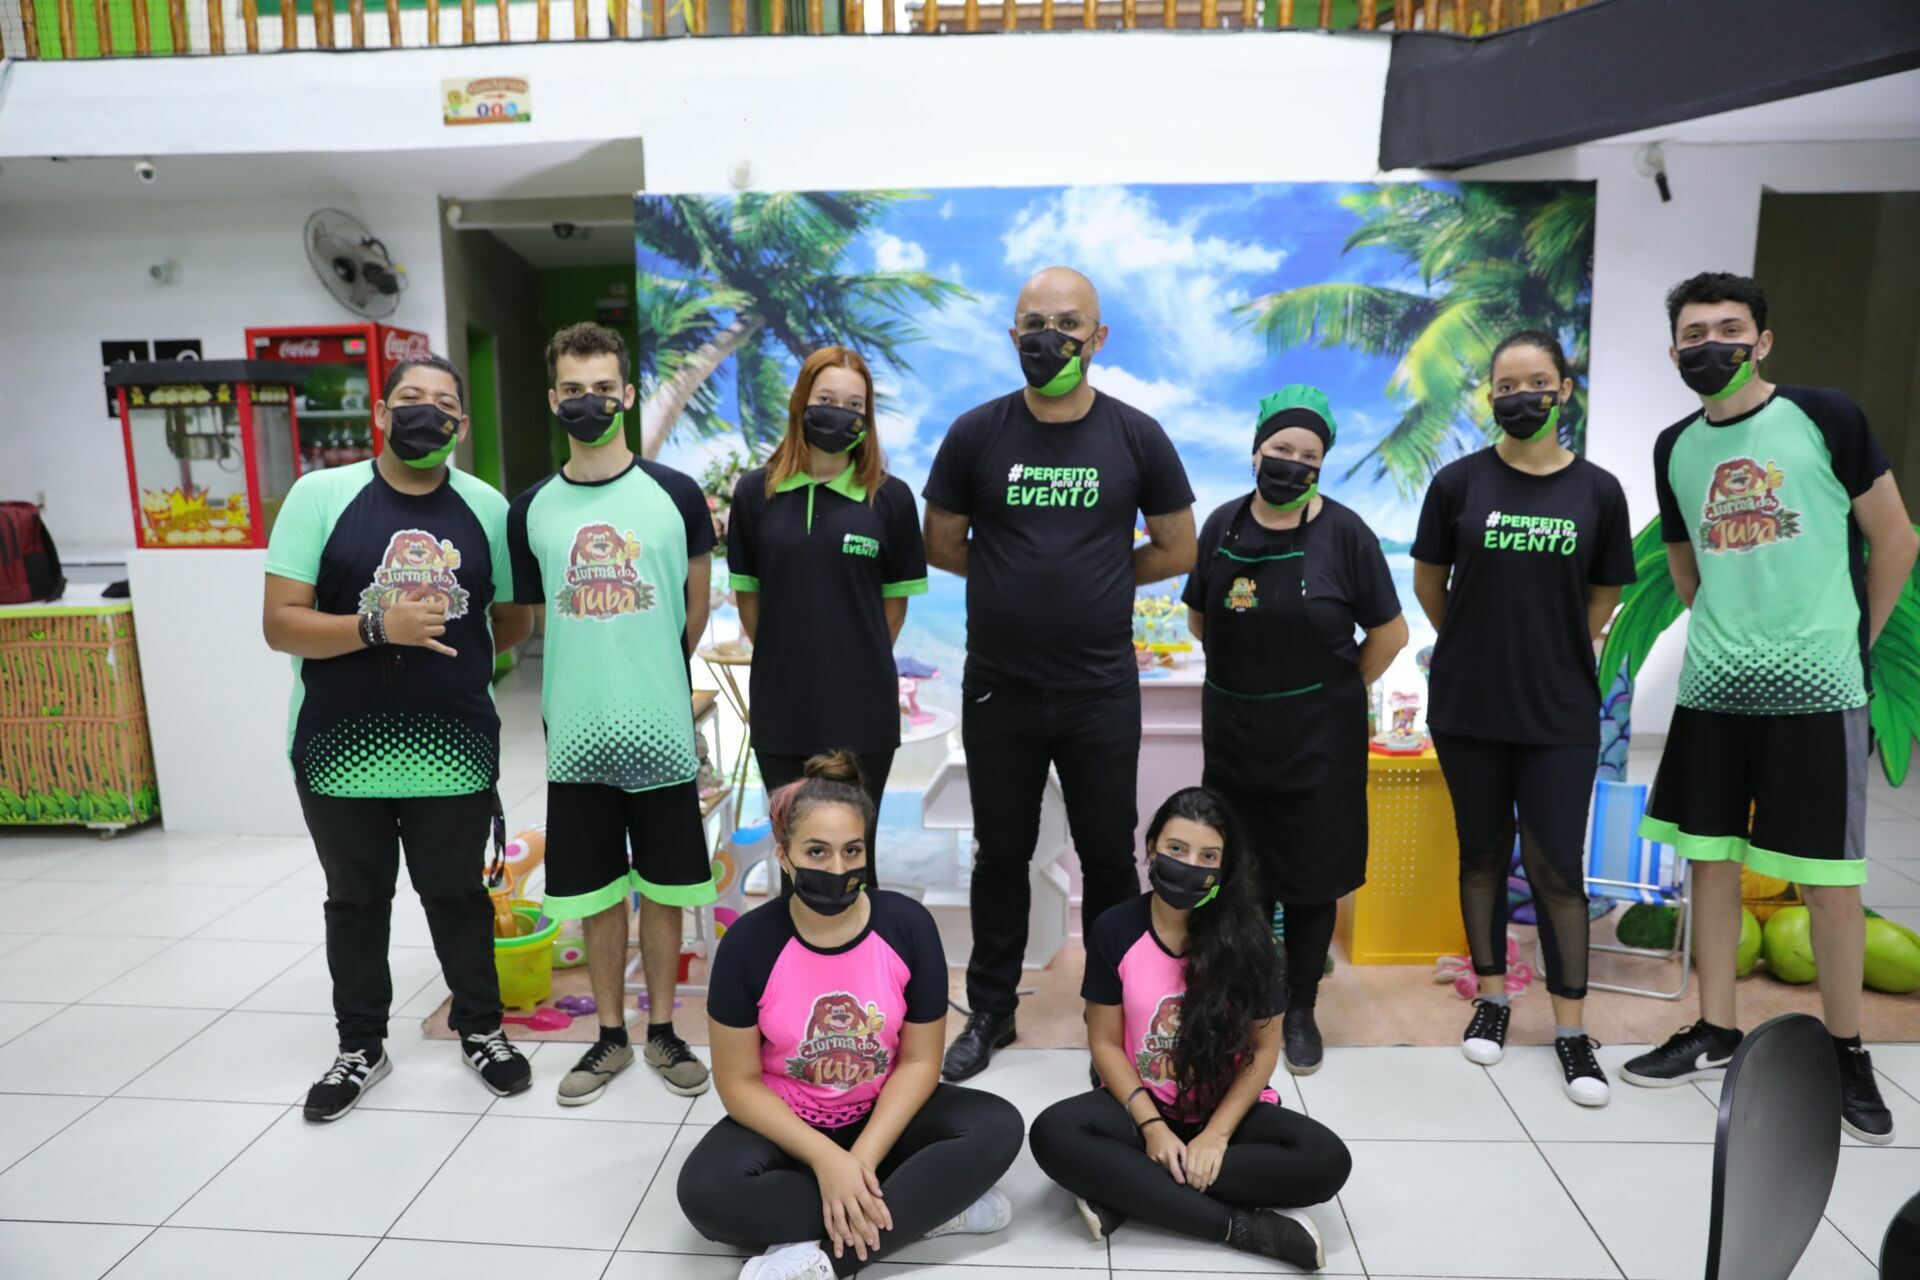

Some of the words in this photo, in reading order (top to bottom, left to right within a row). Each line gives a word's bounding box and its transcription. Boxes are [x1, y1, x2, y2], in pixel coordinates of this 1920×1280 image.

[1008, 463, 1099, 483] #PERFEITO
[1006, 485, 1099, 508] EVENTO
[1485, 511, 1577, 531] #PERFEITO
[1484, 530, 1577, 556] EVENTO
[376, 567, 432, 583] Turma
[433, 567, 449, 583] do
[574, 583, 637, 620] Tuba
[801, 1036, 858, 1056] Turma
[810, 1054, 877, 1086] Tuba
